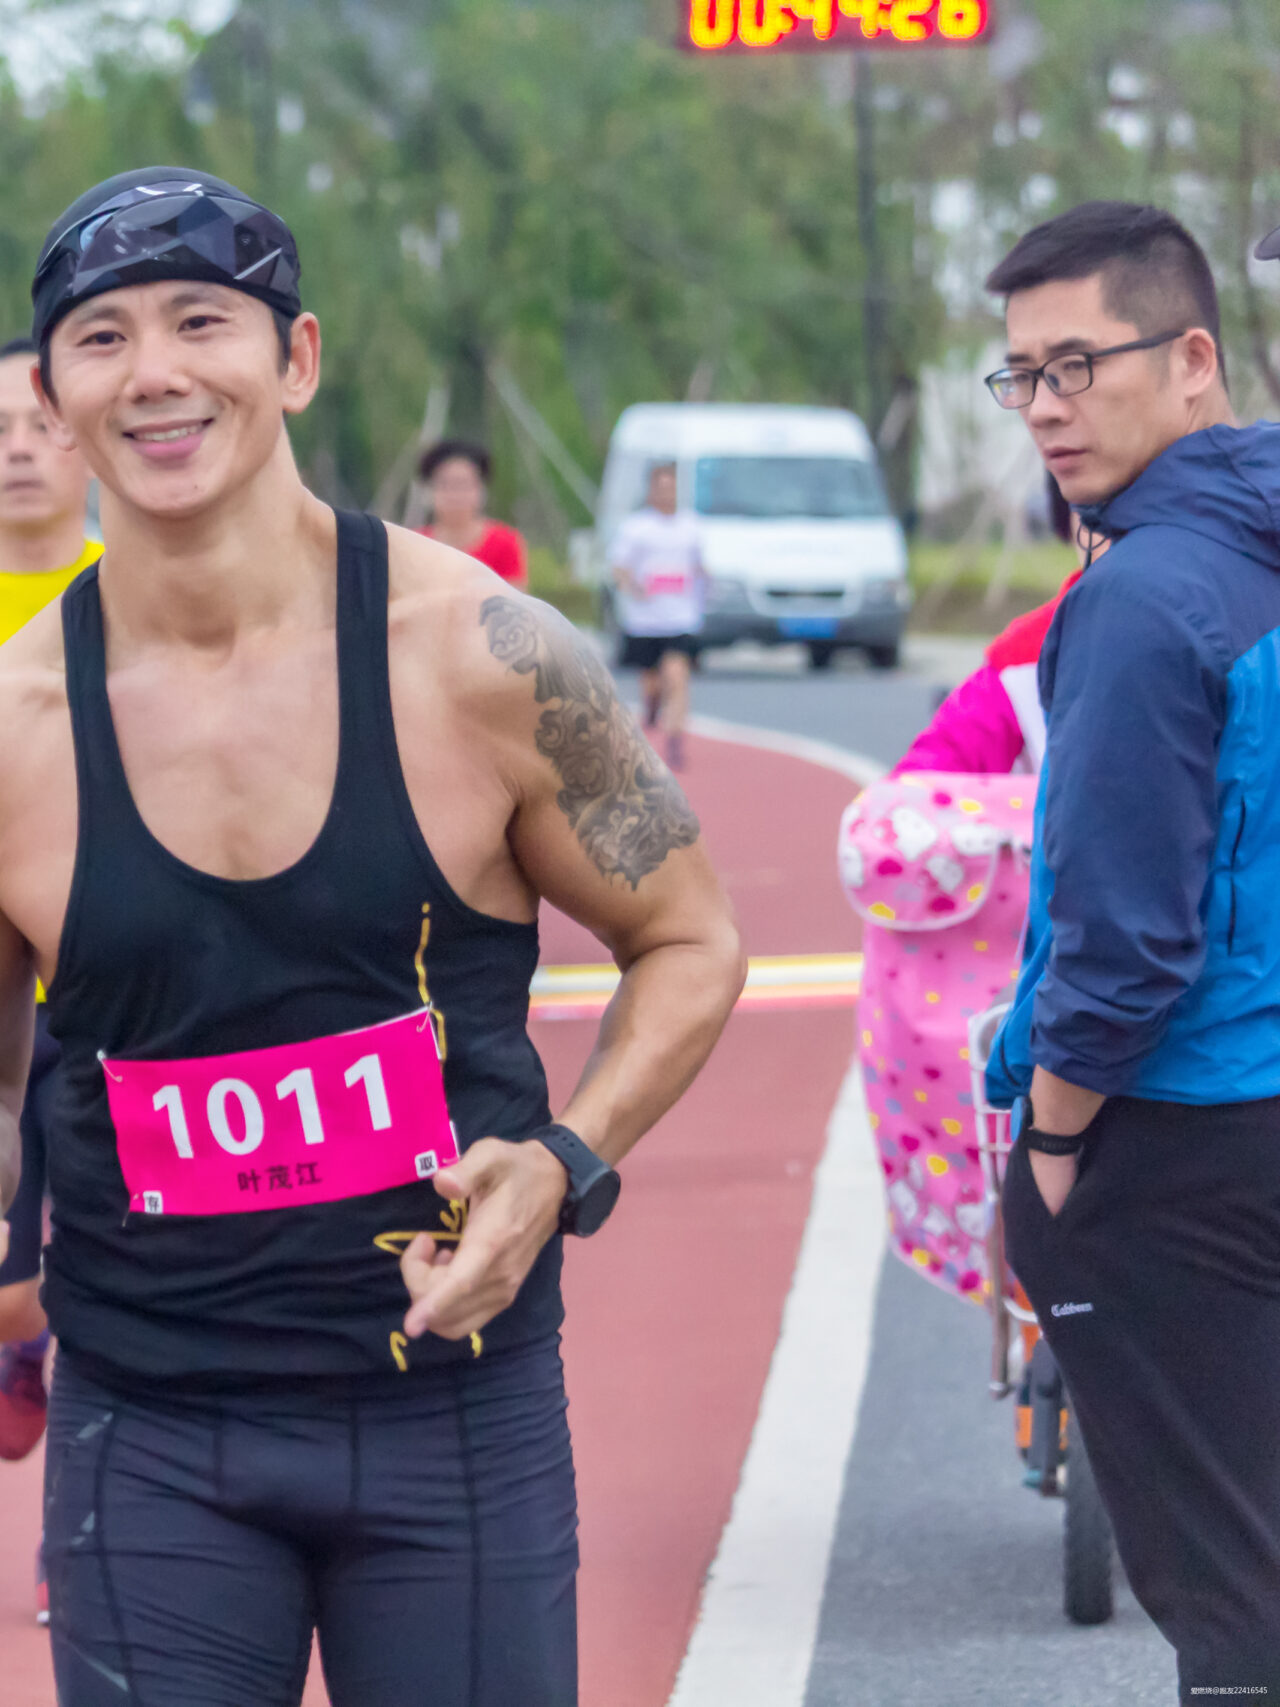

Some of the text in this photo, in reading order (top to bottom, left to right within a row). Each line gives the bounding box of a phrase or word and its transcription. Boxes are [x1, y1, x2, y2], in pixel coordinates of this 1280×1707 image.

[152, 1053, 392, 1160] 1011
[236, 1161, 323, 1194] 叶茂江
